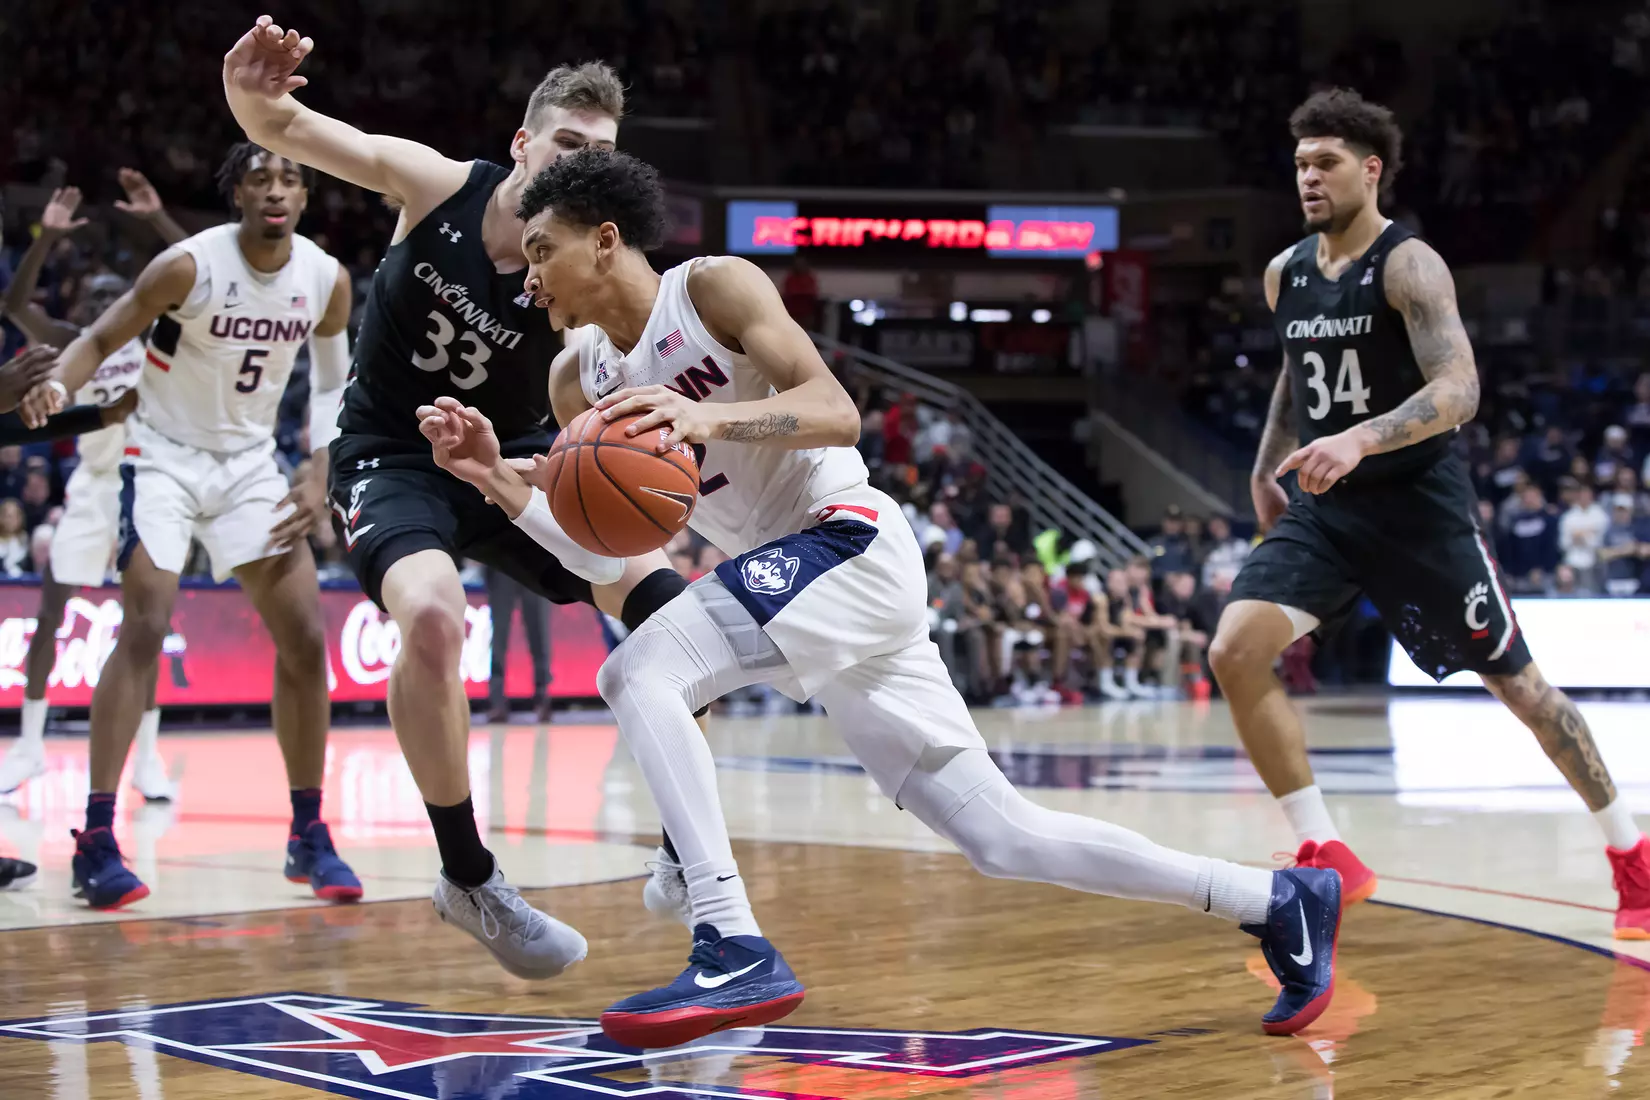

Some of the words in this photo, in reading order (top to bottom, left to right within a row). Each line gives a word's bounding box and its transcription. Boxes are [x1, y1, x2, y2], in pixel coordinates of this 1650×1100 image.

[209, 315, 312, 342] UCONN
[413, 262, 525, 350] CINCINNATI
[1285, 314, 1374, 339] CINCINNATI
[235, 348, 270, 394] 5
[411, 309, 493, 390] 33
[1302, 348, 1372, 421] 34
